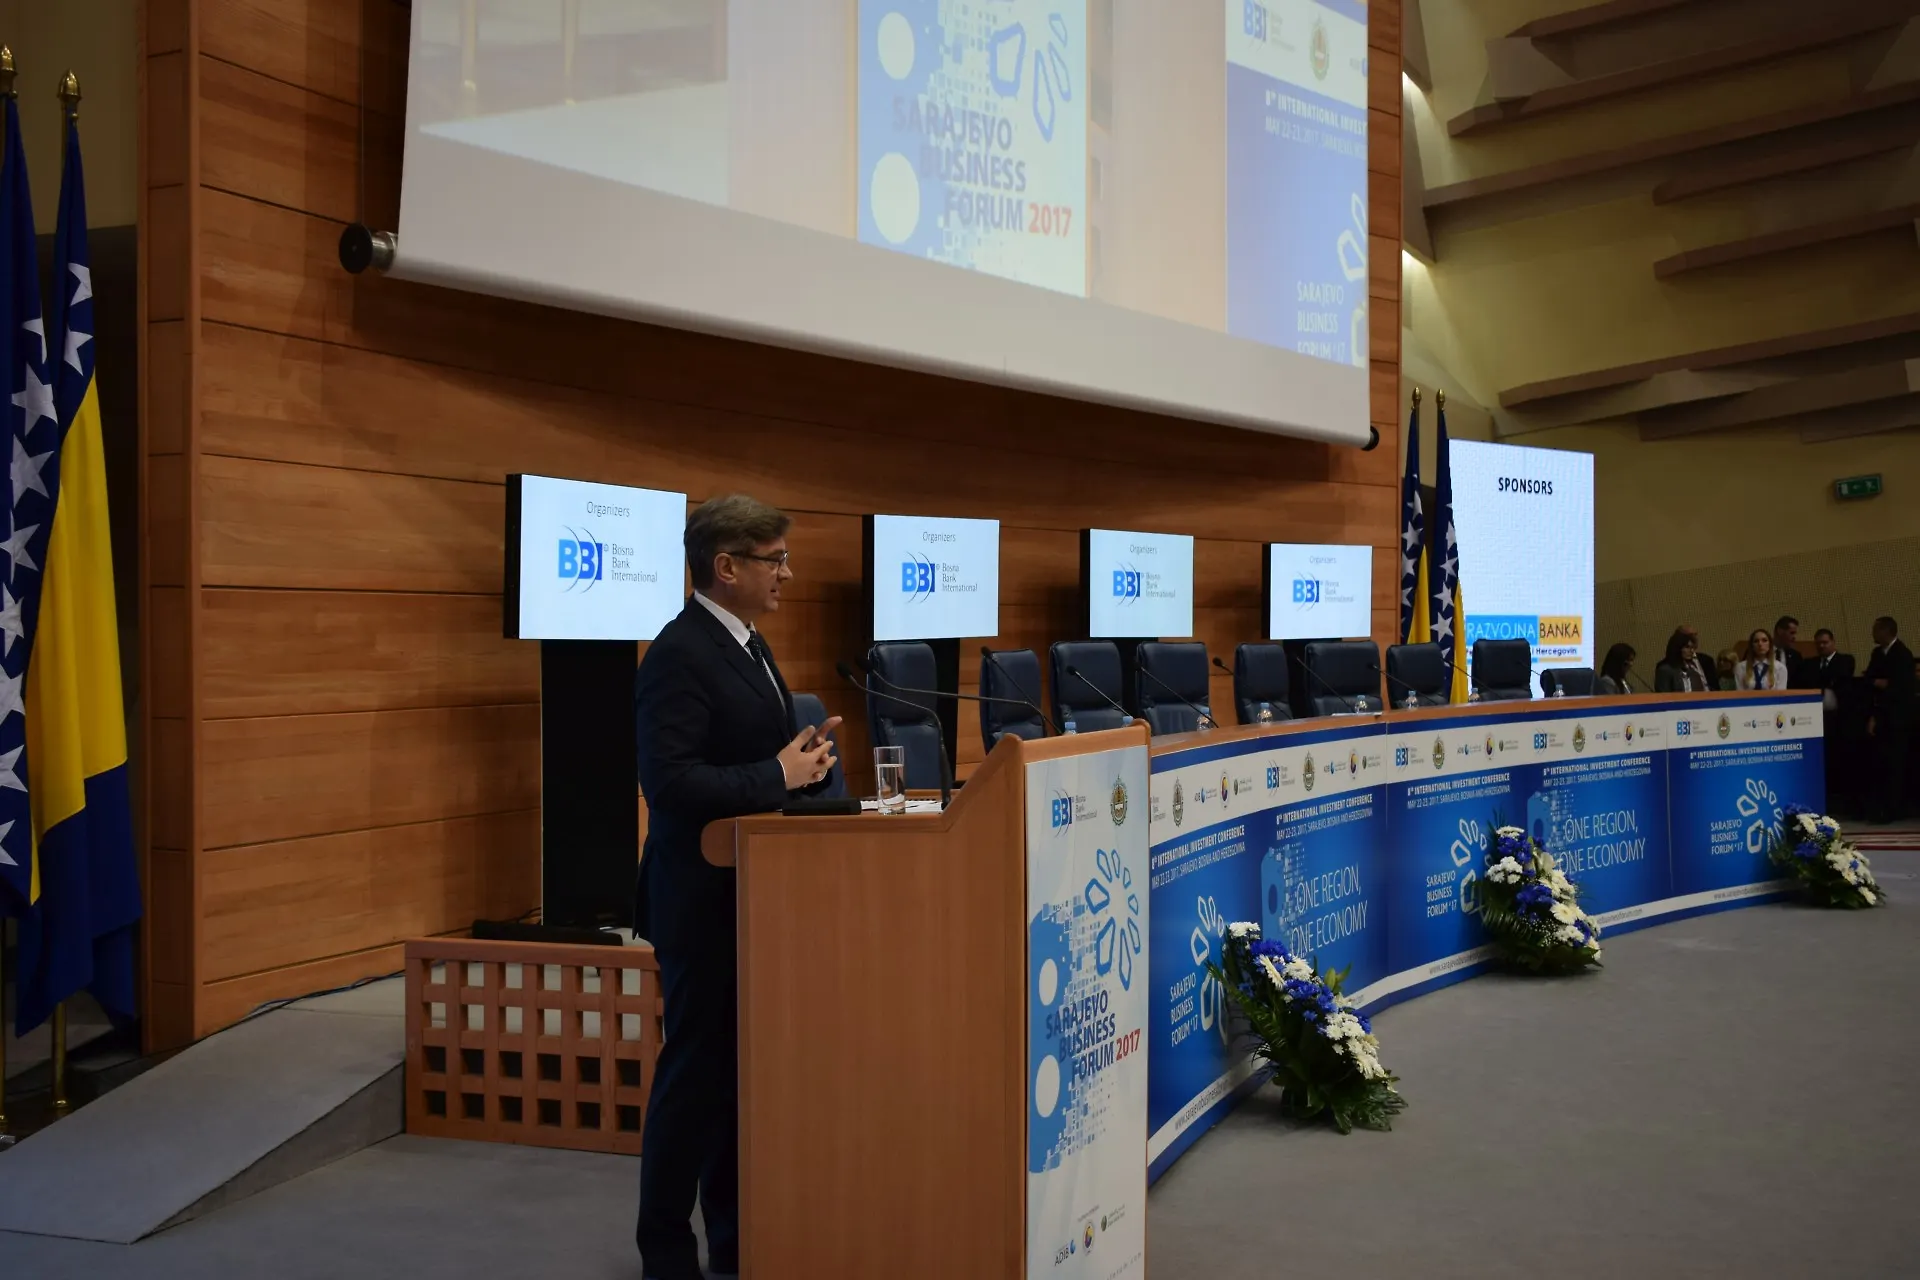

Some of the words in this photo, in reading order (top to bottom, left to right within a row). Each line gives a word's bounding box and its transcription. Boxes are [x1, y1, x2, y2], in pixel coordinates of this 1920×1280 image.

[892, 94, 1012, 151] SARAJEVO
[1278, 93, 1339, 129] INTERNATIONAL
[920, 143, 1026, 192] BUSINESS
[945, 187, 1024, 232] FORUM
[1028, 202, 1072, 237] 2017
[1296, 280, 1344, 308] SARAJEVO
[1298, 310, 1338, 334] BUSINESS
[1498, 476, 1553, 495] SPONSORS
[586, 501, 630, 518] Organizers
[922, 531, 956, 544] Organizers
[558, 538, 602, 580] BBI
[612, 543, 634, 556] Bosna
[1130, 544, 1158, 555] Organizers
[612, 556, 630, 568] Bank
[942, 563, 960, 572] Bosna
[611, 570, 658, 583] International
[902, 562, 936, 592] BBI
[942, 573, 956, 582] Bank
[942, 584, 978, 592] International
[1112, 570, 1140, 598] BBI
[1292, 580, 1320, 603] BBI
[1466, 622, 1536, 639] RAZVOJNA
[1540, 622, 1580, 638] BANKA
[1536, 647, 1577, 656] Hercegovin
[1677, 722, 1690, 735] BBI
[1534, 734, 1547, 749] BBI
[1698, 749, 1737, 758] INTERNATIONAL
[1738, 746, 1770, 755] INVESTMENT
[1770, 743, 1802, 752] CONFERENCE
[1396, 748, 1408, 766] BBI
[1550, 764, 1589, 775] INTERNATIONAL
[1590, 760, 1620, 770] INVESTMENT
[1620, 756, 1651, 766] CONFERENCE
[1267, 766, 1279, 789] BBI
[1414, 782, 1451, 795] INTERNATIONAL
[1452, 777, 1480, 789] INVESTMENT
[1481, 772, 1510, 784] CONFERENCE
[1052, 797, 1072, 828] BBI
[1283, 806, 1318, 823] INTERNATIONAL
[1319, 800, 1345, 814] INVESTMENT
[1346, 793, 1372, 808] CONFERENCE
[1565, 816, 1590, 842] ONE
[1593, 809, 1638, 838] REGION,
[1710, 819, 1742, 831] SARAJEVO
[1158, 844, 1190, 867] INTERNATIONAL
[1190, 834, 1217, 853] INVESTMENT
[1218, 825, 1245, 843] CONFERENCE
[1711, 831, 1738, 843] BUSINESS
[1560, 848, 1584, 874] ONE
[1587, 837, 1646, 870] ECONOMY
[1711, 843, 1733, 855] FORUM
[1296, 877, 1320, 914] ONE
[1322, 861, 1361, 903] REGION,
[1426, 870, 1455, 887] SARAJEVO
[1427, 886, 1452, 903] BUSINESS
[1428, 902, 1448, 918] FORUM
[1291, 921, 1314, 958] ONE
[1316, 900, 1368, 948] ECONOMY
[1170, 972, 1196, 1002] SARAJEVO
[1045, 990, 1108, 1040] SARAJEVO
[1171, 996, 1193, 1025] BUSINESS
[1060, 1013, 1116, 1063] BUSINESS
[1172, 1020, 1190, 1047] FORUM
[1071, 1041, 1114, 1088] FORUM
[1116, 1028, 1140, 1061] 2017
